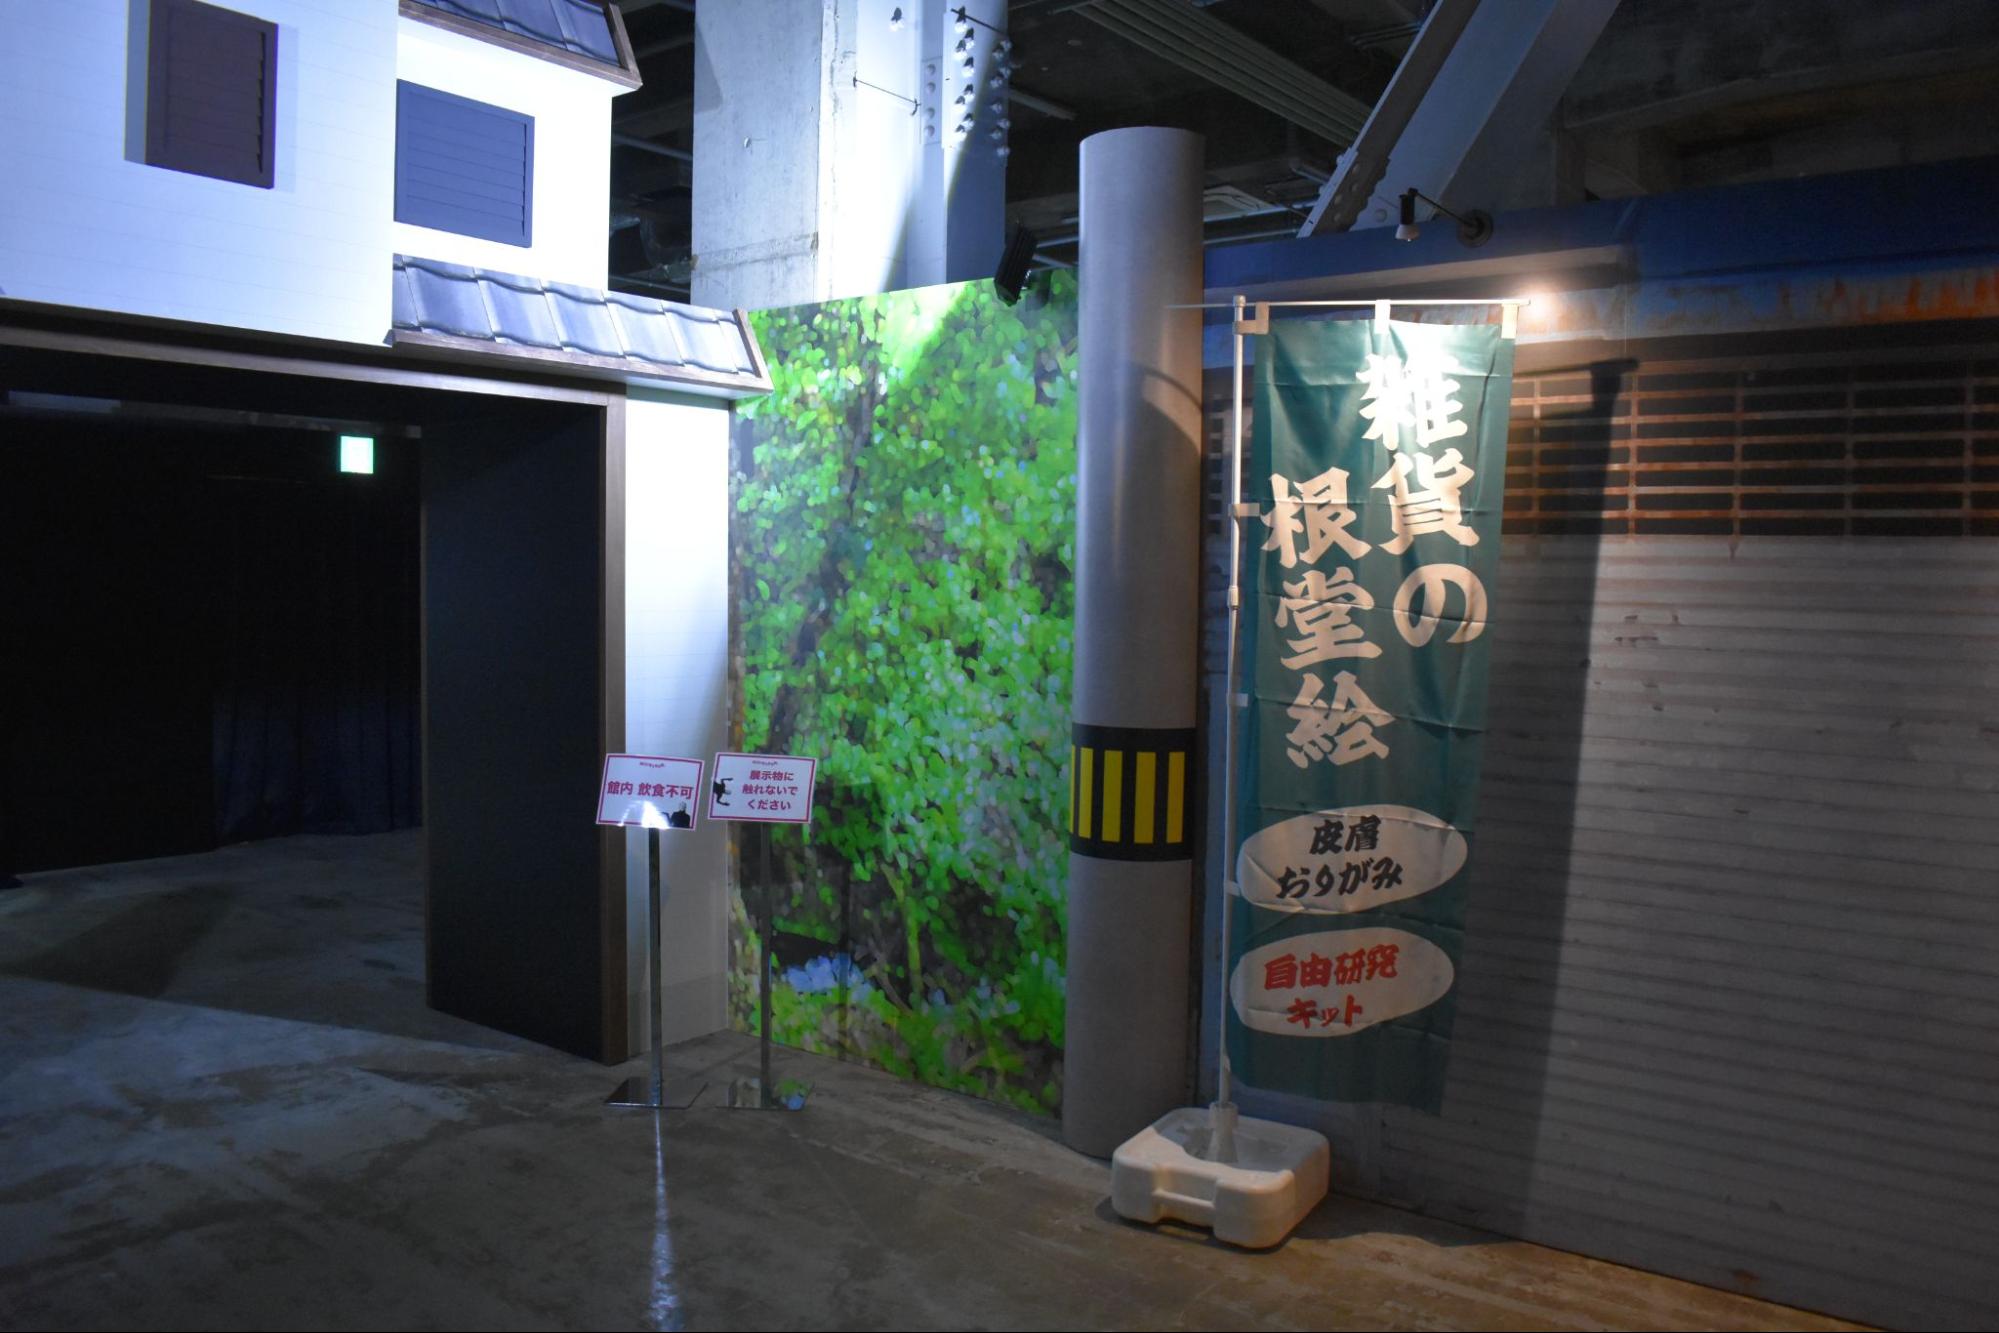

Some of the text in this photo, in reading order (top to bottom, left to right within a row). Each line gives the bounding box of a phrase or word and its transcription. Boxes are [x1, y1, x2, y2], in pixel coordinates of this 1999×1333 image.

[1355, 344, 1488, 648] 雑貨の
[1260, 466, 1396, 769] 根堂絵
[607, 781, 694, 800] 館内 飲食不可
[742, 784, 799, 796] 触れないで
[749, 770, 795, 782] 展示物に
[748, 799, 792, 811] ください
[1309, 814, 1382, 855] 皮膚
[1276, 856, 1403, 899] おりがみ
[1264, 943, 1400, 991] 自由研究
[1286, 995, 1363, 1029] キット
